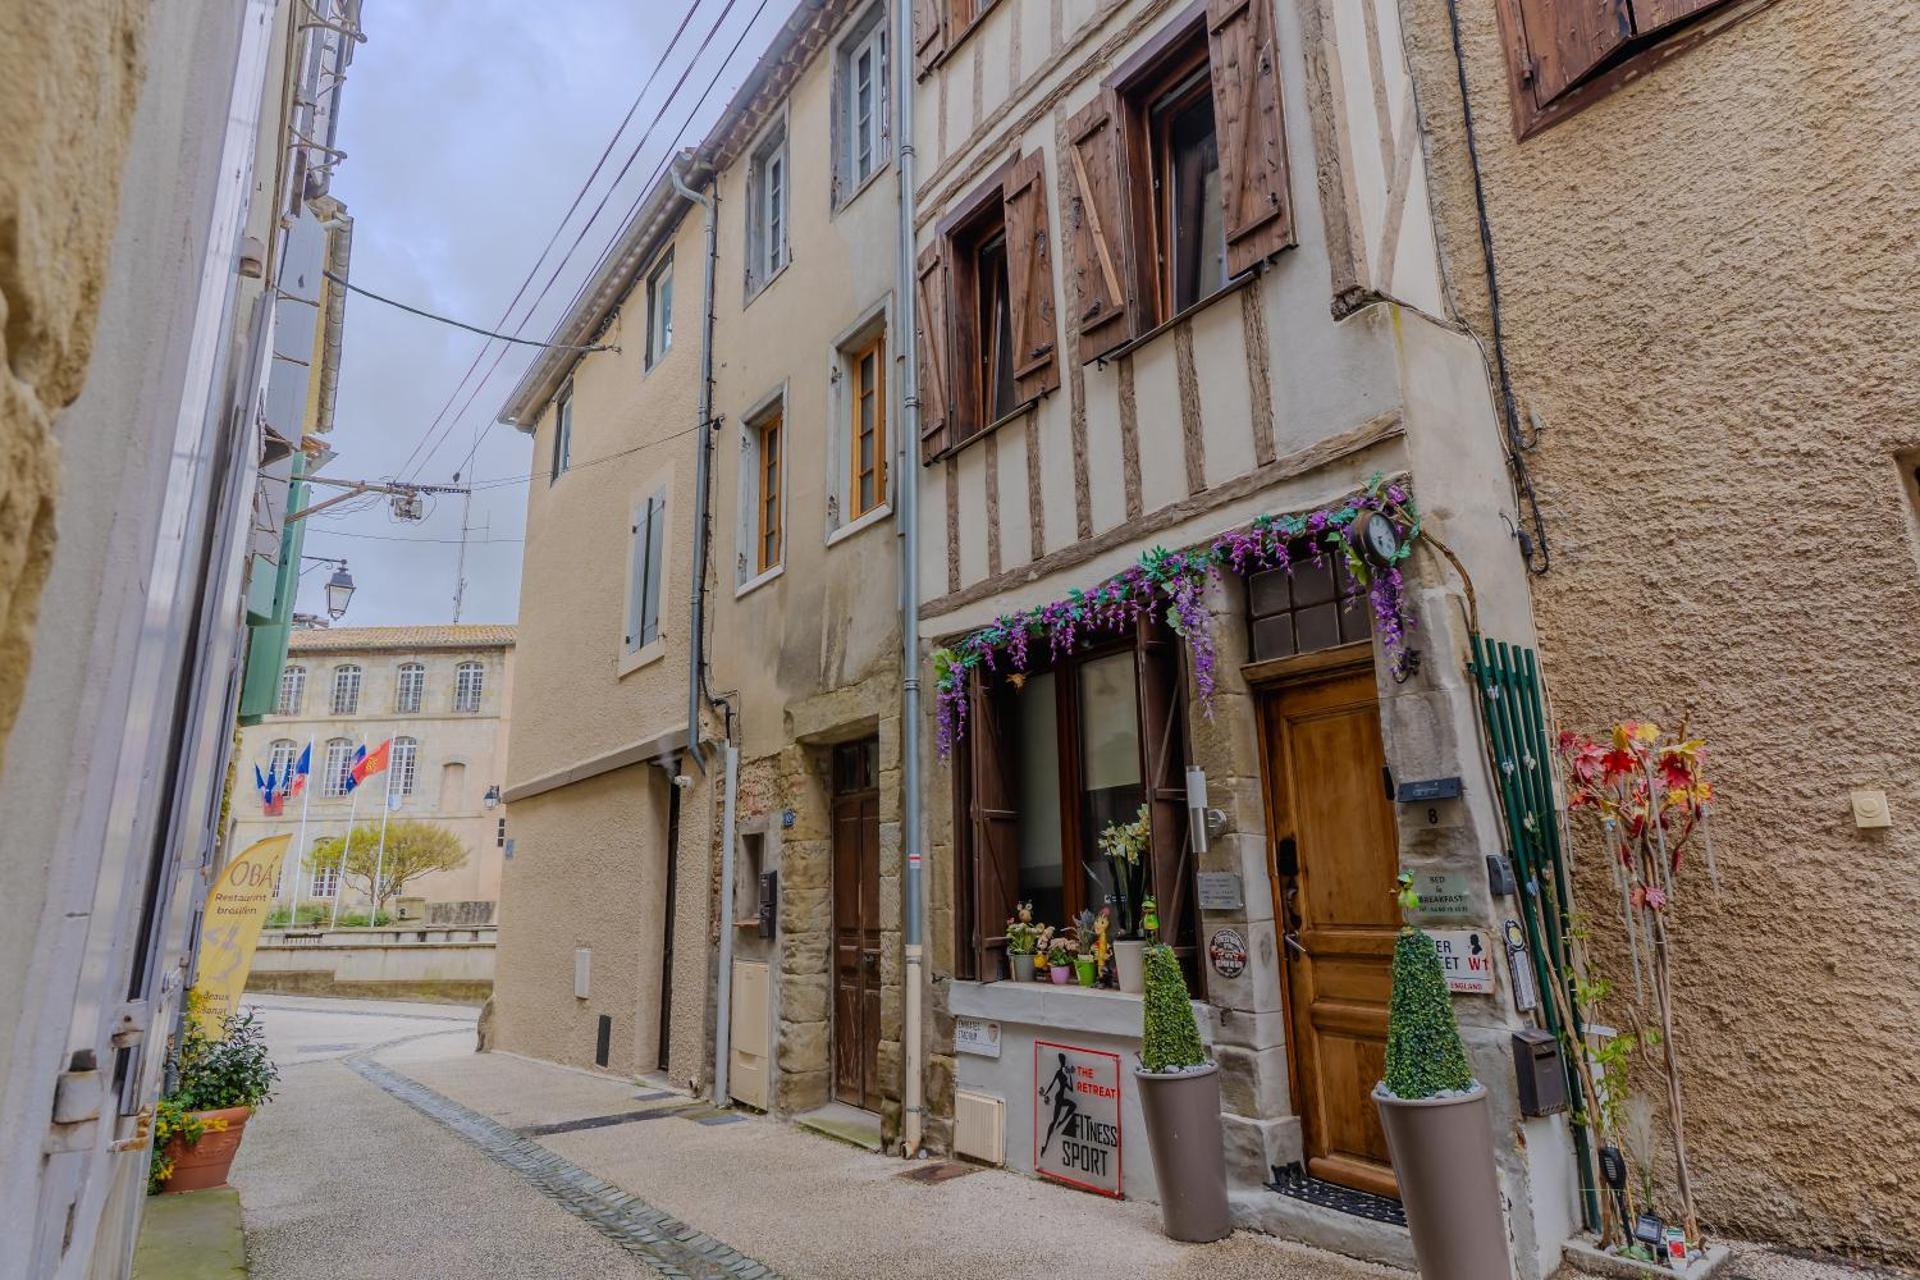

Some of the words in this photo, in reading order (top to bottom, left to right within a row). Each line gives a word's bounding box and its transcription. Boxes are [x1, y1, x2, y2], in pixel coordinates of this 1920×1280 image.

[1428, 808, 1438, 824] 8
[215, 892, 267, 902] Restaurant
[1417, 895, 1463, 903] BREAKFAST
[1468, 957, 1489, 971] W1
[1450, 982, 1482, 990] ENGLAND
[1076, 1066, 1094, 1079] THE
[1076, 1082, 1116, 1099] RETREAT
[1062, 1141, 1108, 1177] SPORT
